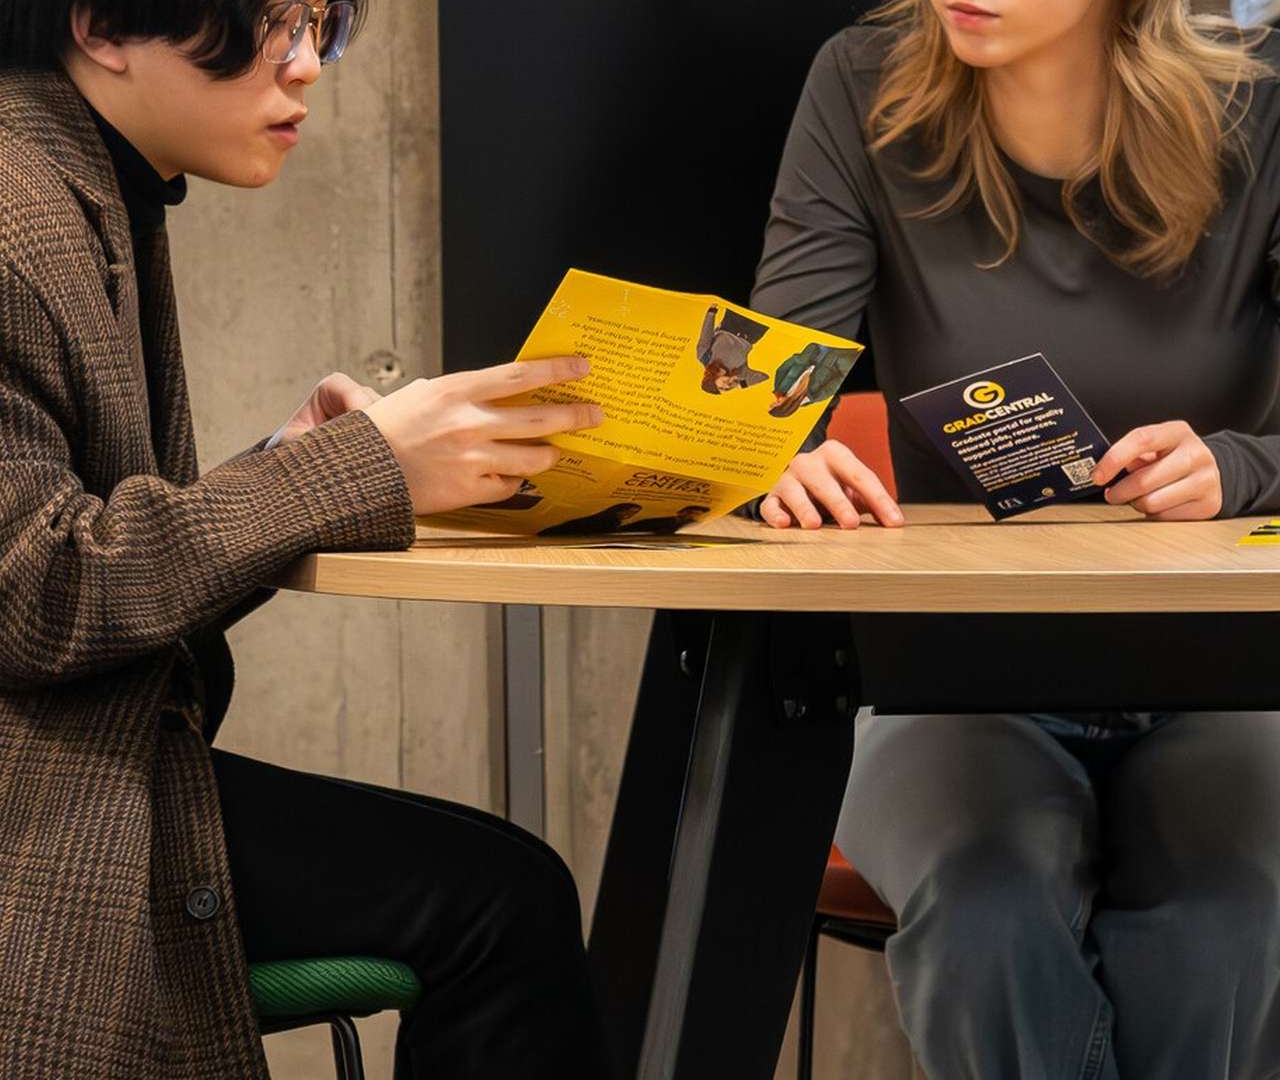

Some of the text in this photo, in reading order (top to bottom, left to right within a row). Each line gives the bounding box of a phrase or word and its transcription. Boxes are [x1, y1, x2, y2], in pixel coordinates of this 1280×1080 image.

[943, 392, 1055, 434] GRADCENTRAL
[951, 431, 992, 447] Graduate
[992, 422, 1019, 435] portal
[1033, 407, 1065, 422] quality
[956, 419, 1056, 454] assured jobs, resources,
[962, 433, 1040, 462] support and more.
[624, 479, 712, 495] CENTRAL
[632, 472, 711, 488] CAREER
